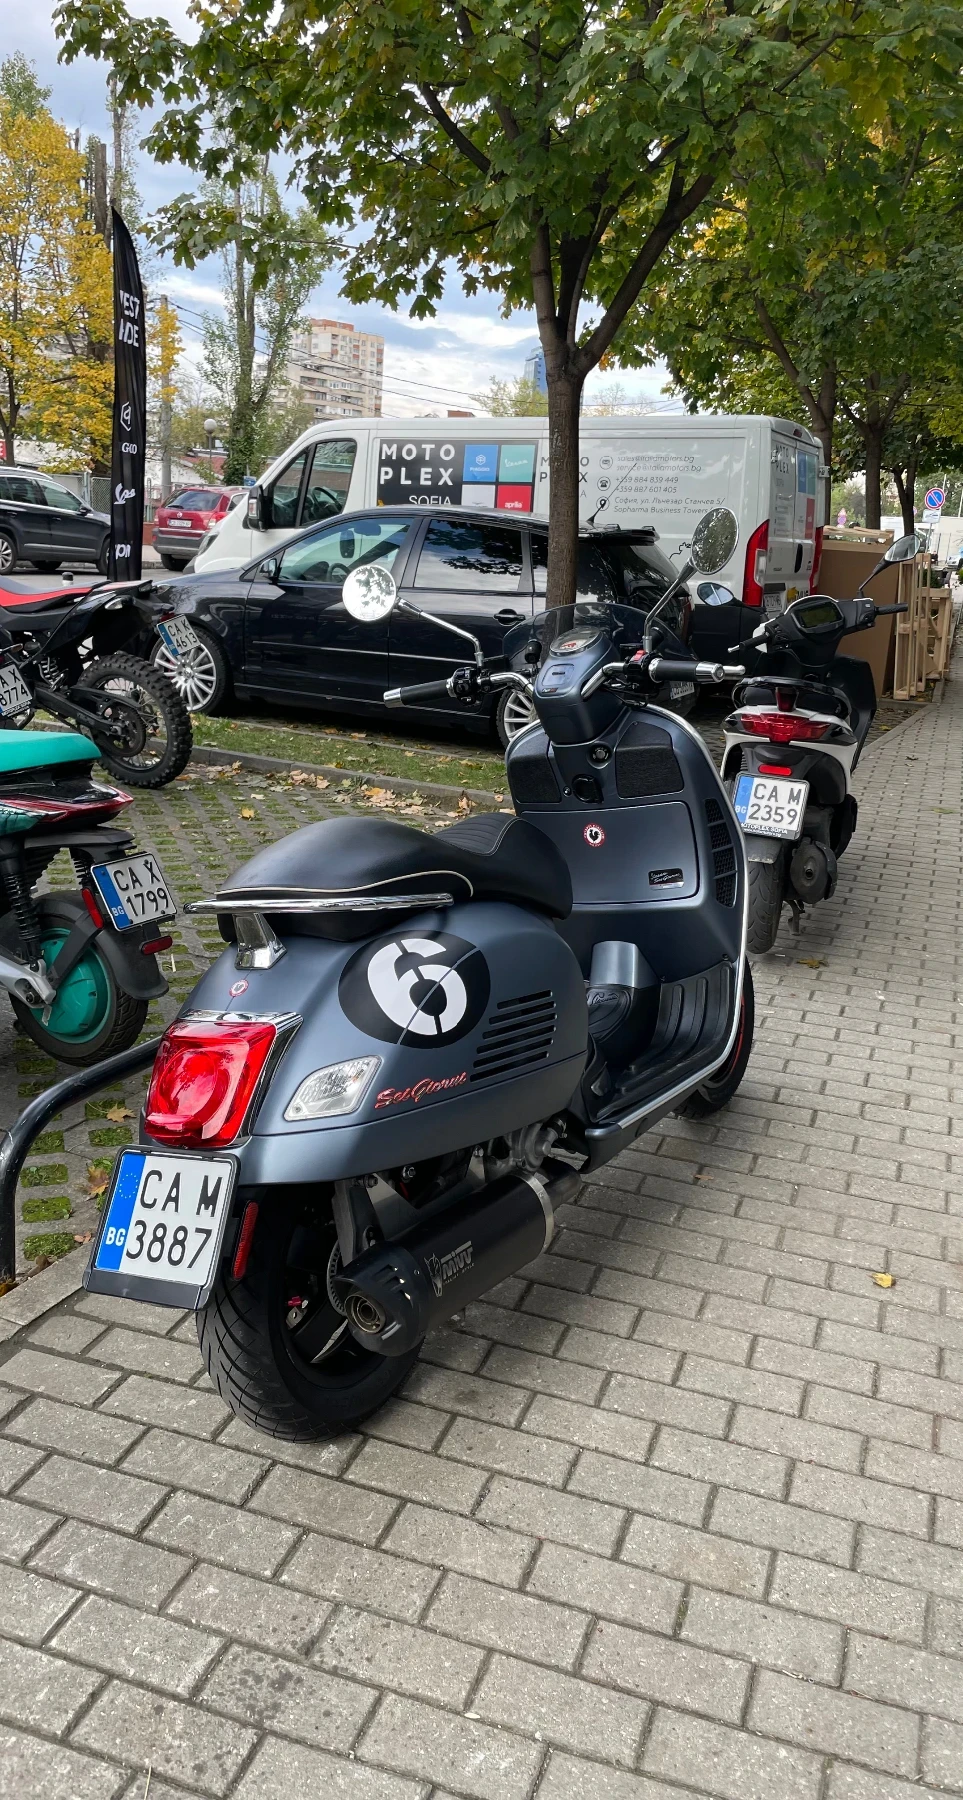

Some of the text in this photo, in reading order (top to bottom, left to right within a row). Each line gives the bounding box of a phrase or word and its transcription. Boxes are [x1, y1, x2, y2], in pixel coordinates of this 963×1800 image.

[381, 443, 455, 461] MOTO
[540, 456, 590, 467] MO
[379, 467, 454, 486] PLEX
[650, 506, 681, 514] Business
[167, 619, 190, 637] CA K
[175, 632, 198, 650] 4613
[8, 668, 21, 684] X
[753, 783, 802, 806] CA M
[735, 805, 747, 814] BG
[748, 803, 798, 826] 2359
[112, 861, 161, 892] CA X
[111, 905, 125, 917] BG
[125, 887, 169, 917] 1799
[367, 938, 468, 1036] 6
[139, 1169, 224, 1219] CA M
[105, 1226, 126, 1247] BG
[124, 1219, 214, 1270] 3887
